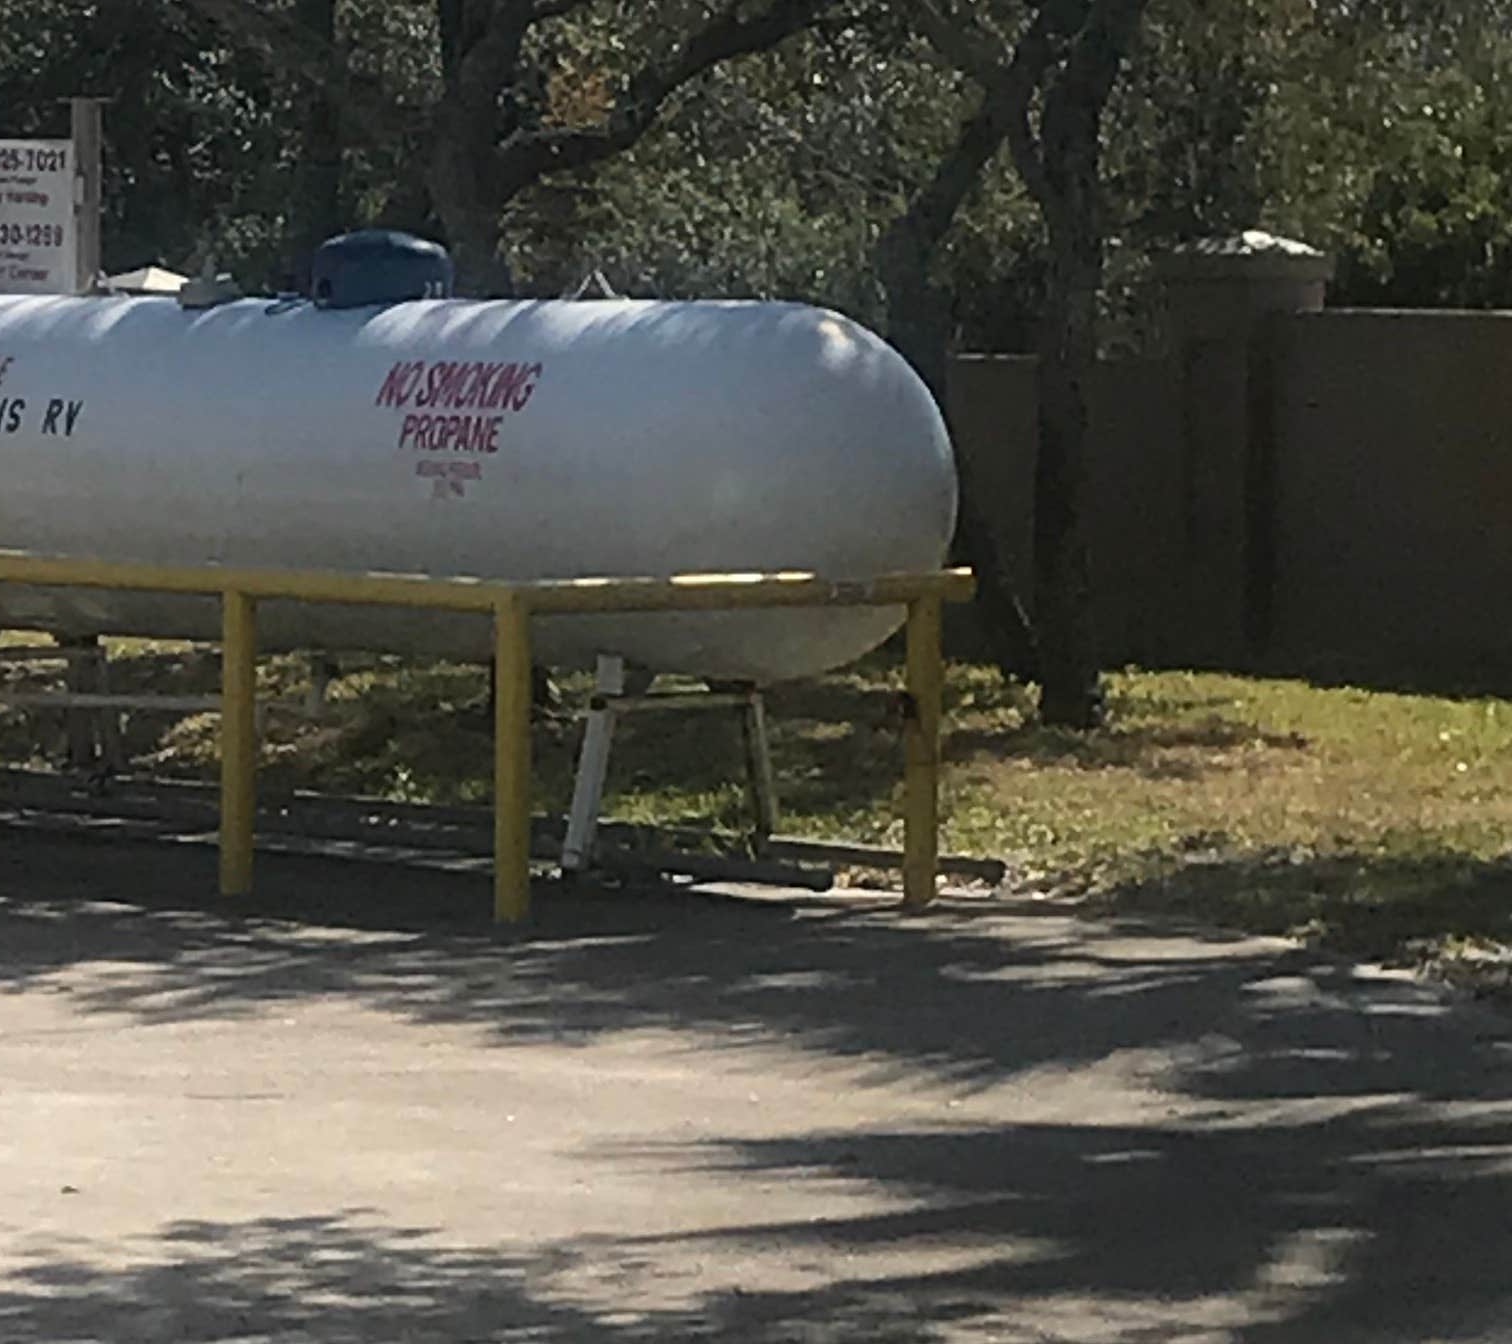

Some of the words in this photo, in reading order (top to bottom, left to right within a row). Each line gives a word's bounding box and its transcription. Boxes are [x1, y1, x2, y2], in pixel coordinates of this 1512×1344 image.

[376, 360, 427, 408] NO
[415, 360, 544, 412] SMOKING
[40, 397, 85, 437] RV
[398, 413, 504, 454] PROPANE
